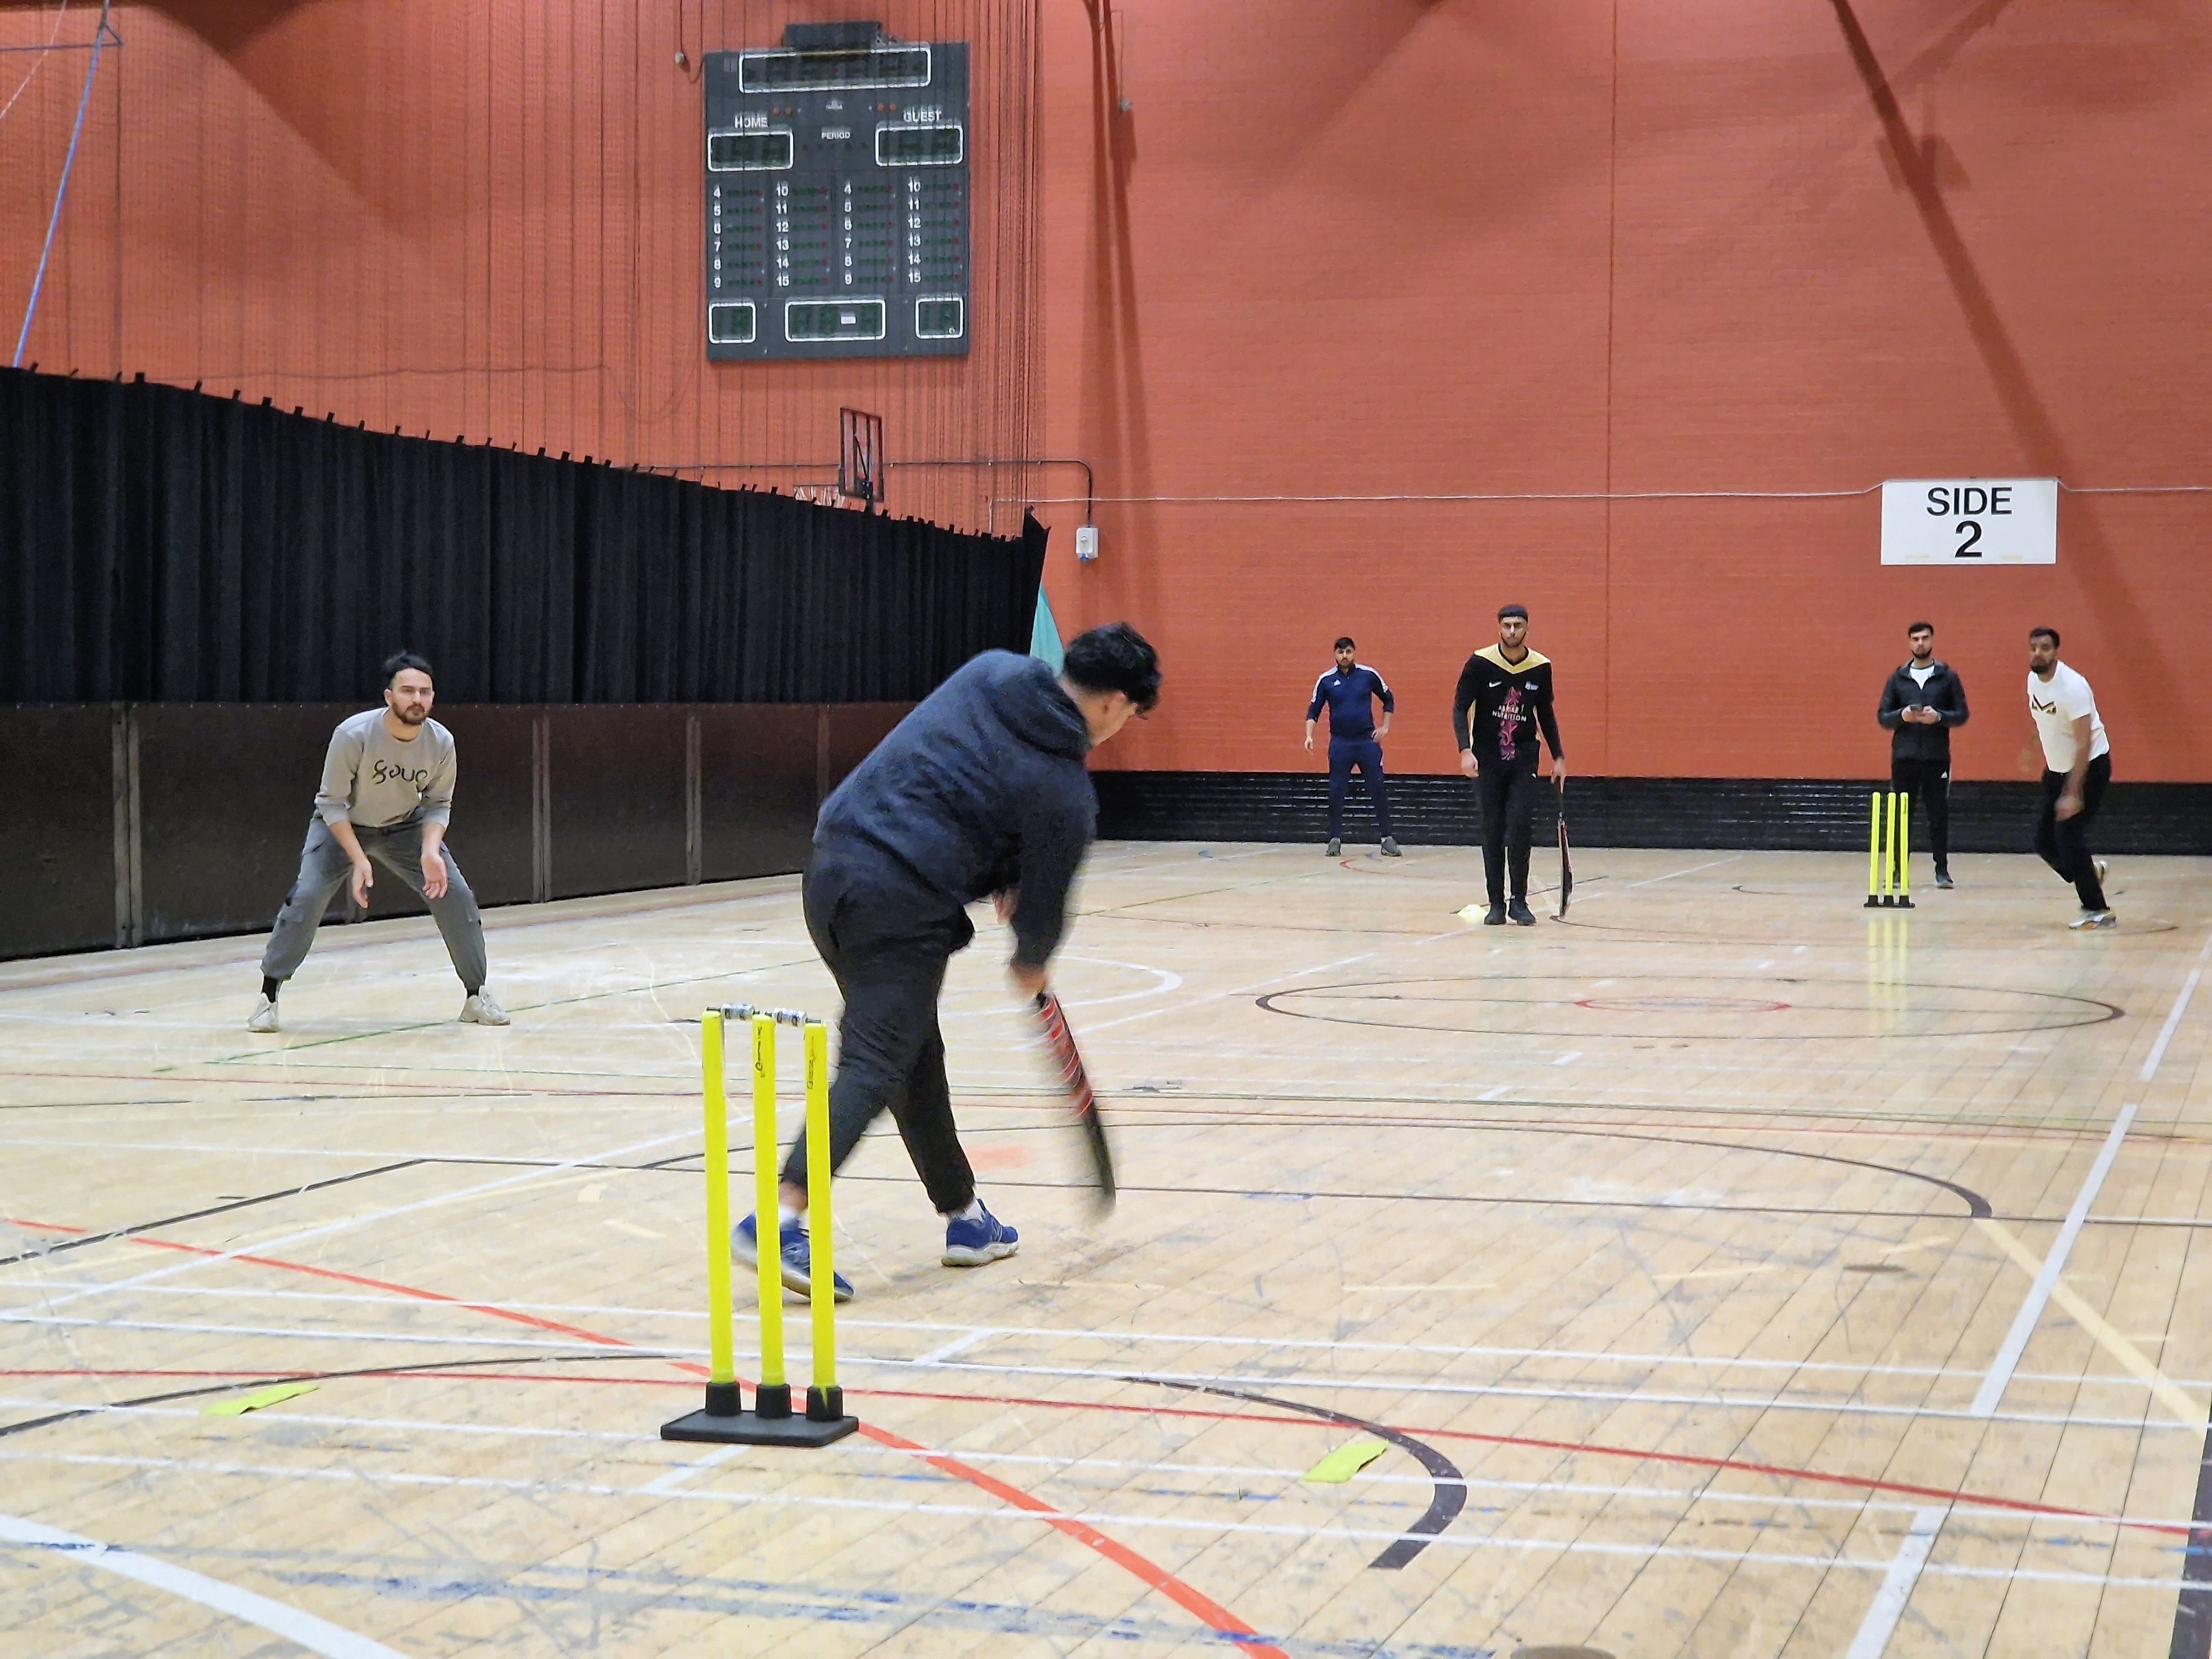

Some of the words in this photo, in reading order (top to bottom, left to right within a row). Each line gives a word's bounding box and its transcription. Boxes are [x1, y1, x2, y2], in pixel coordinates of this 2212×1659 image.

[734, 114, 768, 128] HOME
[903, 107, 942, 122] GUEST
[713, 185, 721, 198] 4
[776, 183, 789, 196] 10
[844, 181, 852, 195] 4
[907, 178, 921, 192] 10
[713, 202, 721, 216] 5
[776, 201, 787, 215] 11
[907, 196, 919, 210] 11
[776, 220, 789, 233] 12
[907, 215, 921, 228] 12
[713, 239, 721, 252] 7
[776, 237, 789, 251] 13
[844, 236, 852, 249] 7
[908, 233, 921, 247] 13
[713, 257, 721, 270] 8
[776, 255, 789, 269] 14
[844, 254, 852, 267] 8
[908, 251, 921, 265] 14
[713, 274, 721, 288] 9
[776, 273, 790, 286] 15
[844, 272, 852, 285] 9
[908, 270, 921, 283] 15
[1926, 487, 2012, 516] SIDE
[1955, 520, 1983, 558] 2
